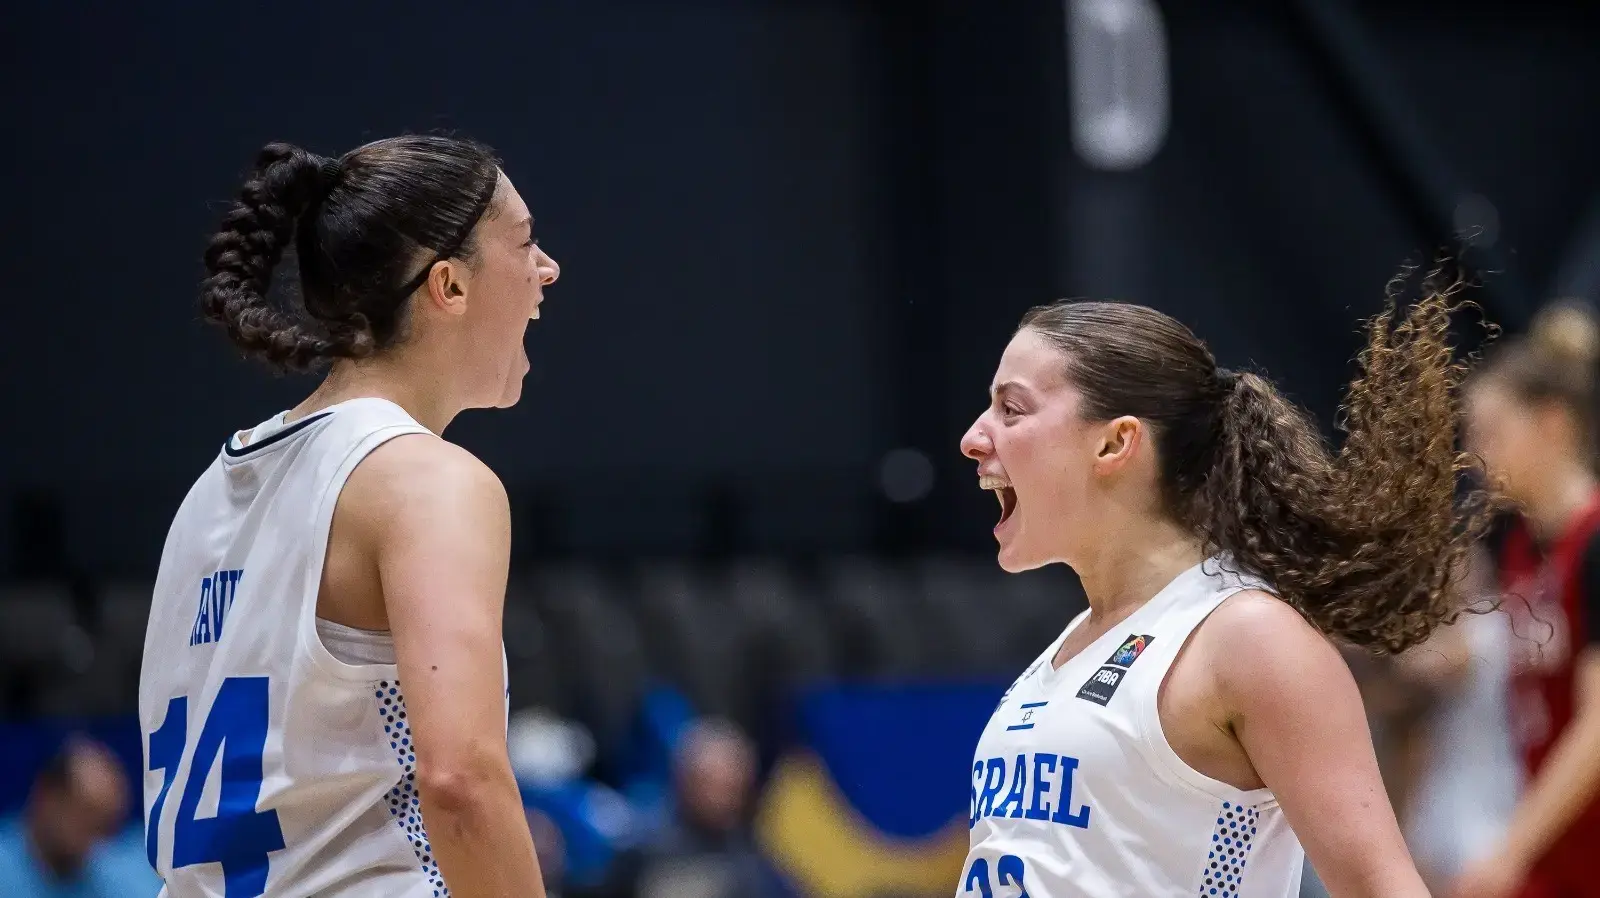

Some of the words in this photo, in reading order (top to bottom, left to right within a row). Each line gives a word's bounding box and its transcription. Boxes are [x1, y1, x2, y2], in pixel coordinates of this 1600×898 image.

[1093, 669, 1120, 686] FIBA
[147, 676, 286, 898] 14
[969, 753, 1091, 829] SRAEL
